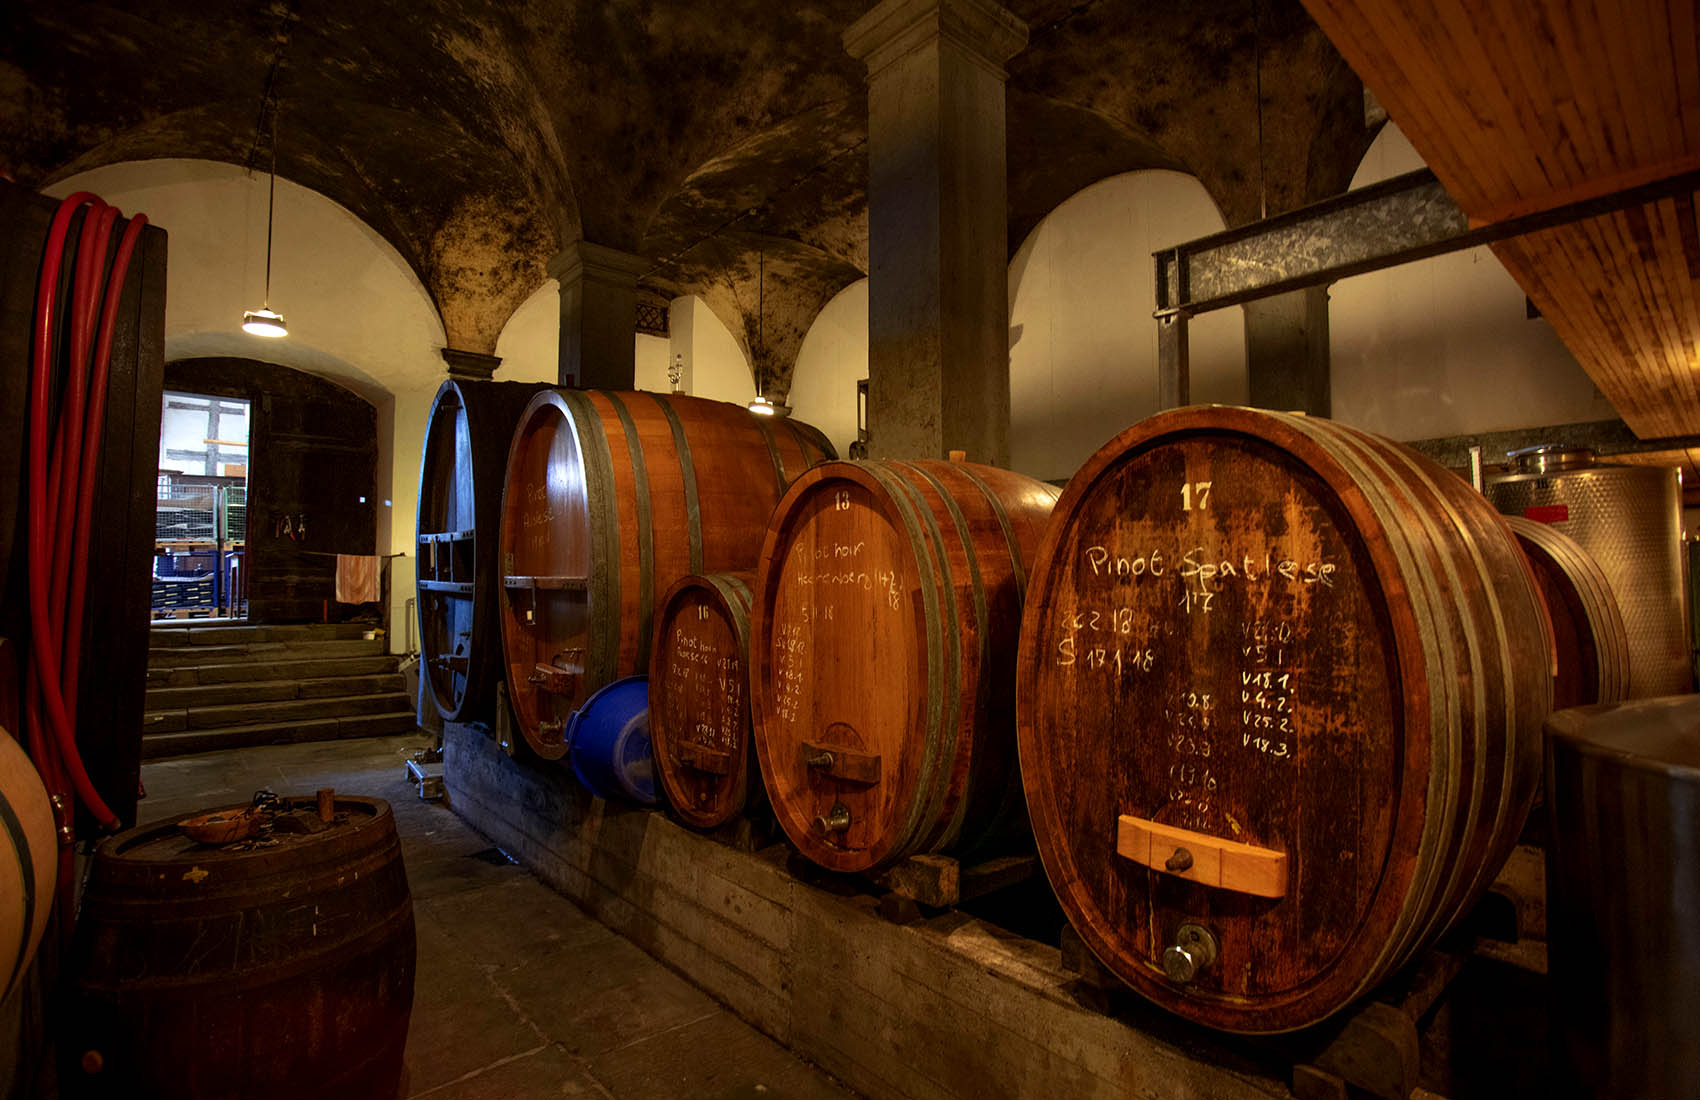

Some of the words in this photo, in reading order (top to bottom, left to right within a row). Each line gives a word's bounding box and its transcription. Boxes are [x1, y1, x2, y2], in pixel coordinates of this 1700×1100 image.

[834, 491, 850, 511] 13
[1180, 481, 1212, 511] 17
[1086, 546, 1164, 576] Pinot
[698, 605, 708, 620] 16
